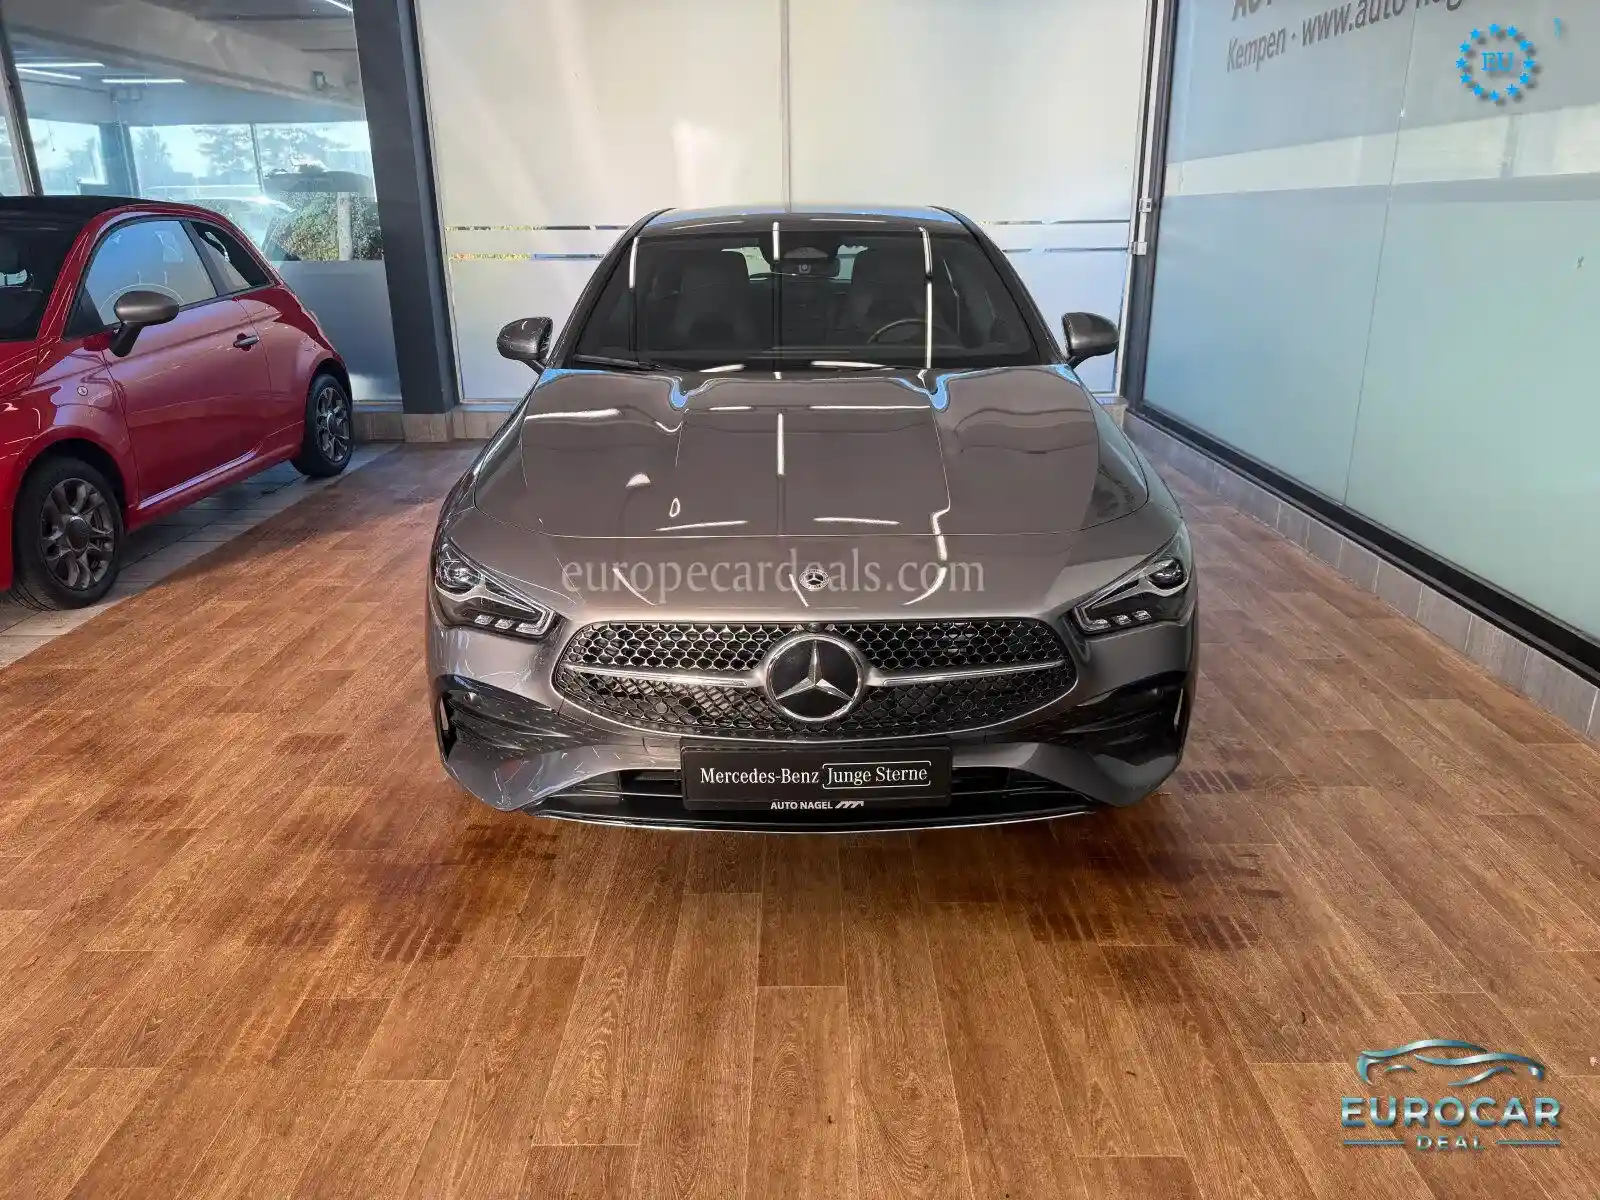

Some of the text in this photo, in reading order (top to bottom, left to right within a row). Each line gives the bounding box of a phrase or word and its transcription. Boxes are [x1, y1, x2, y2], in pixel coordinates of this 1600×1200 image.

[1225, 27, 1286, 72] Kempen
[700, 766, 928, 785] Mercedes-Benz Junge Sterne
[770, 801, 833, 810] AUTO NAGEL
